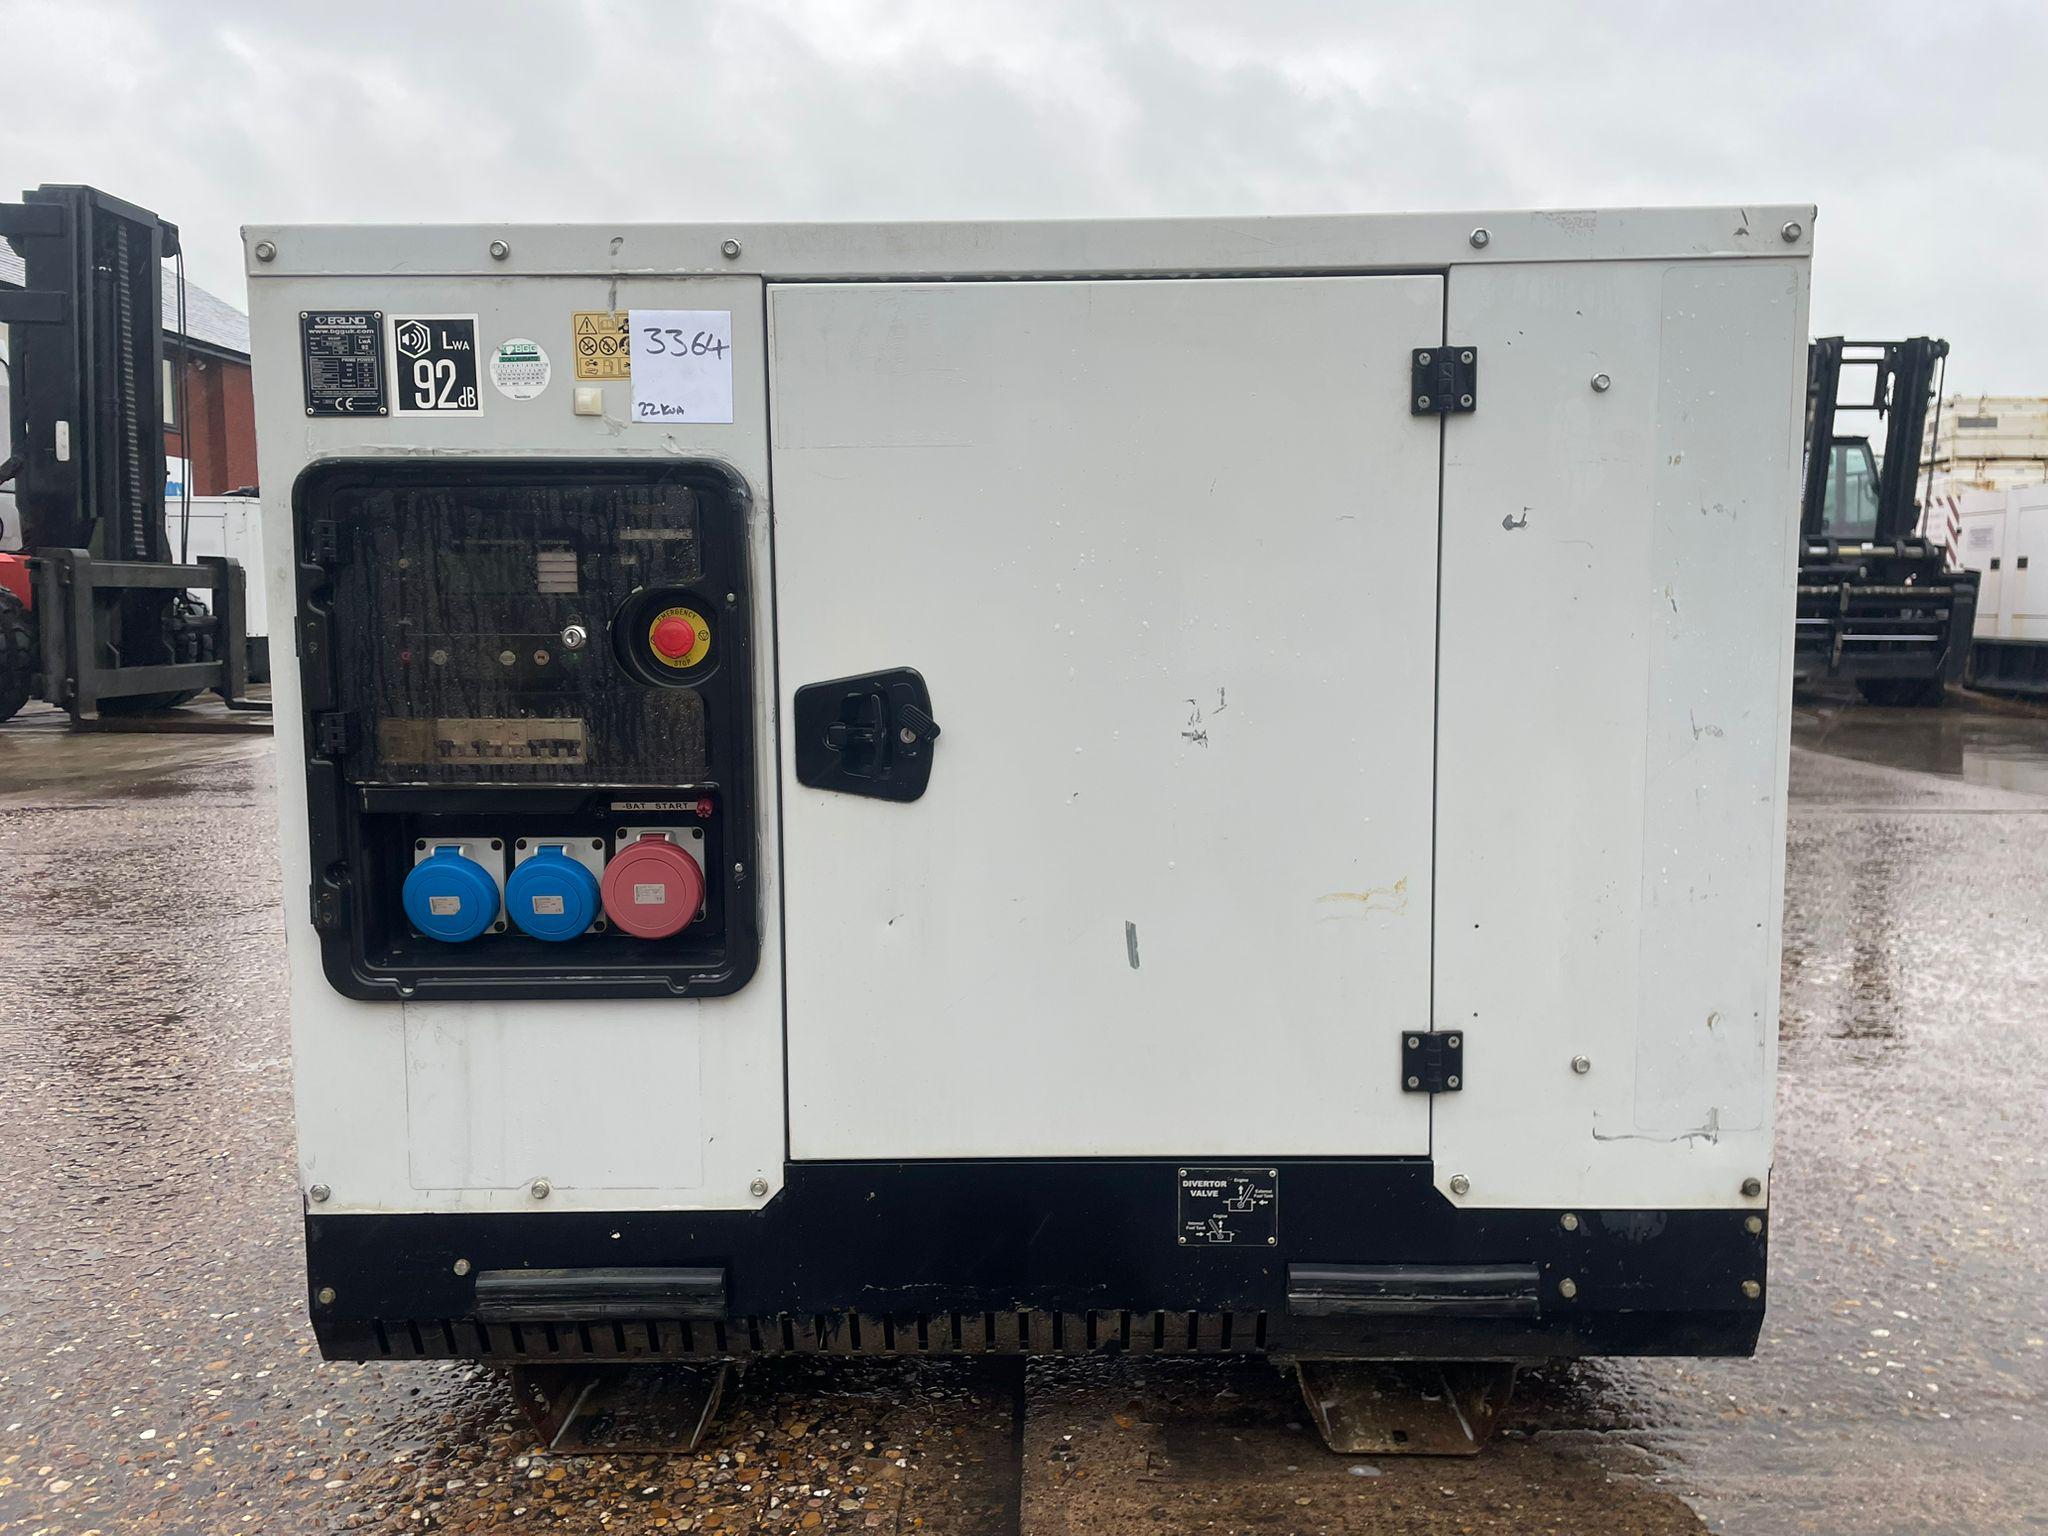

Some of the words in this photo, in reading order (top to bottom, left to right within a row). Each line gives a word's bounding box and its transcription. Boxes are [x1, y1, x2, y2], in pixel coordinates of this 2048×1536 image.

[643, 328, 730, 360] 3364
[413, 358, 458, 409] 92
[458, 386, 477, 408] dB
[657, 607, 697, 622] EMERGENCY
[672, 658, 691, 667] STOP
[655, 802, 688, 810] START
